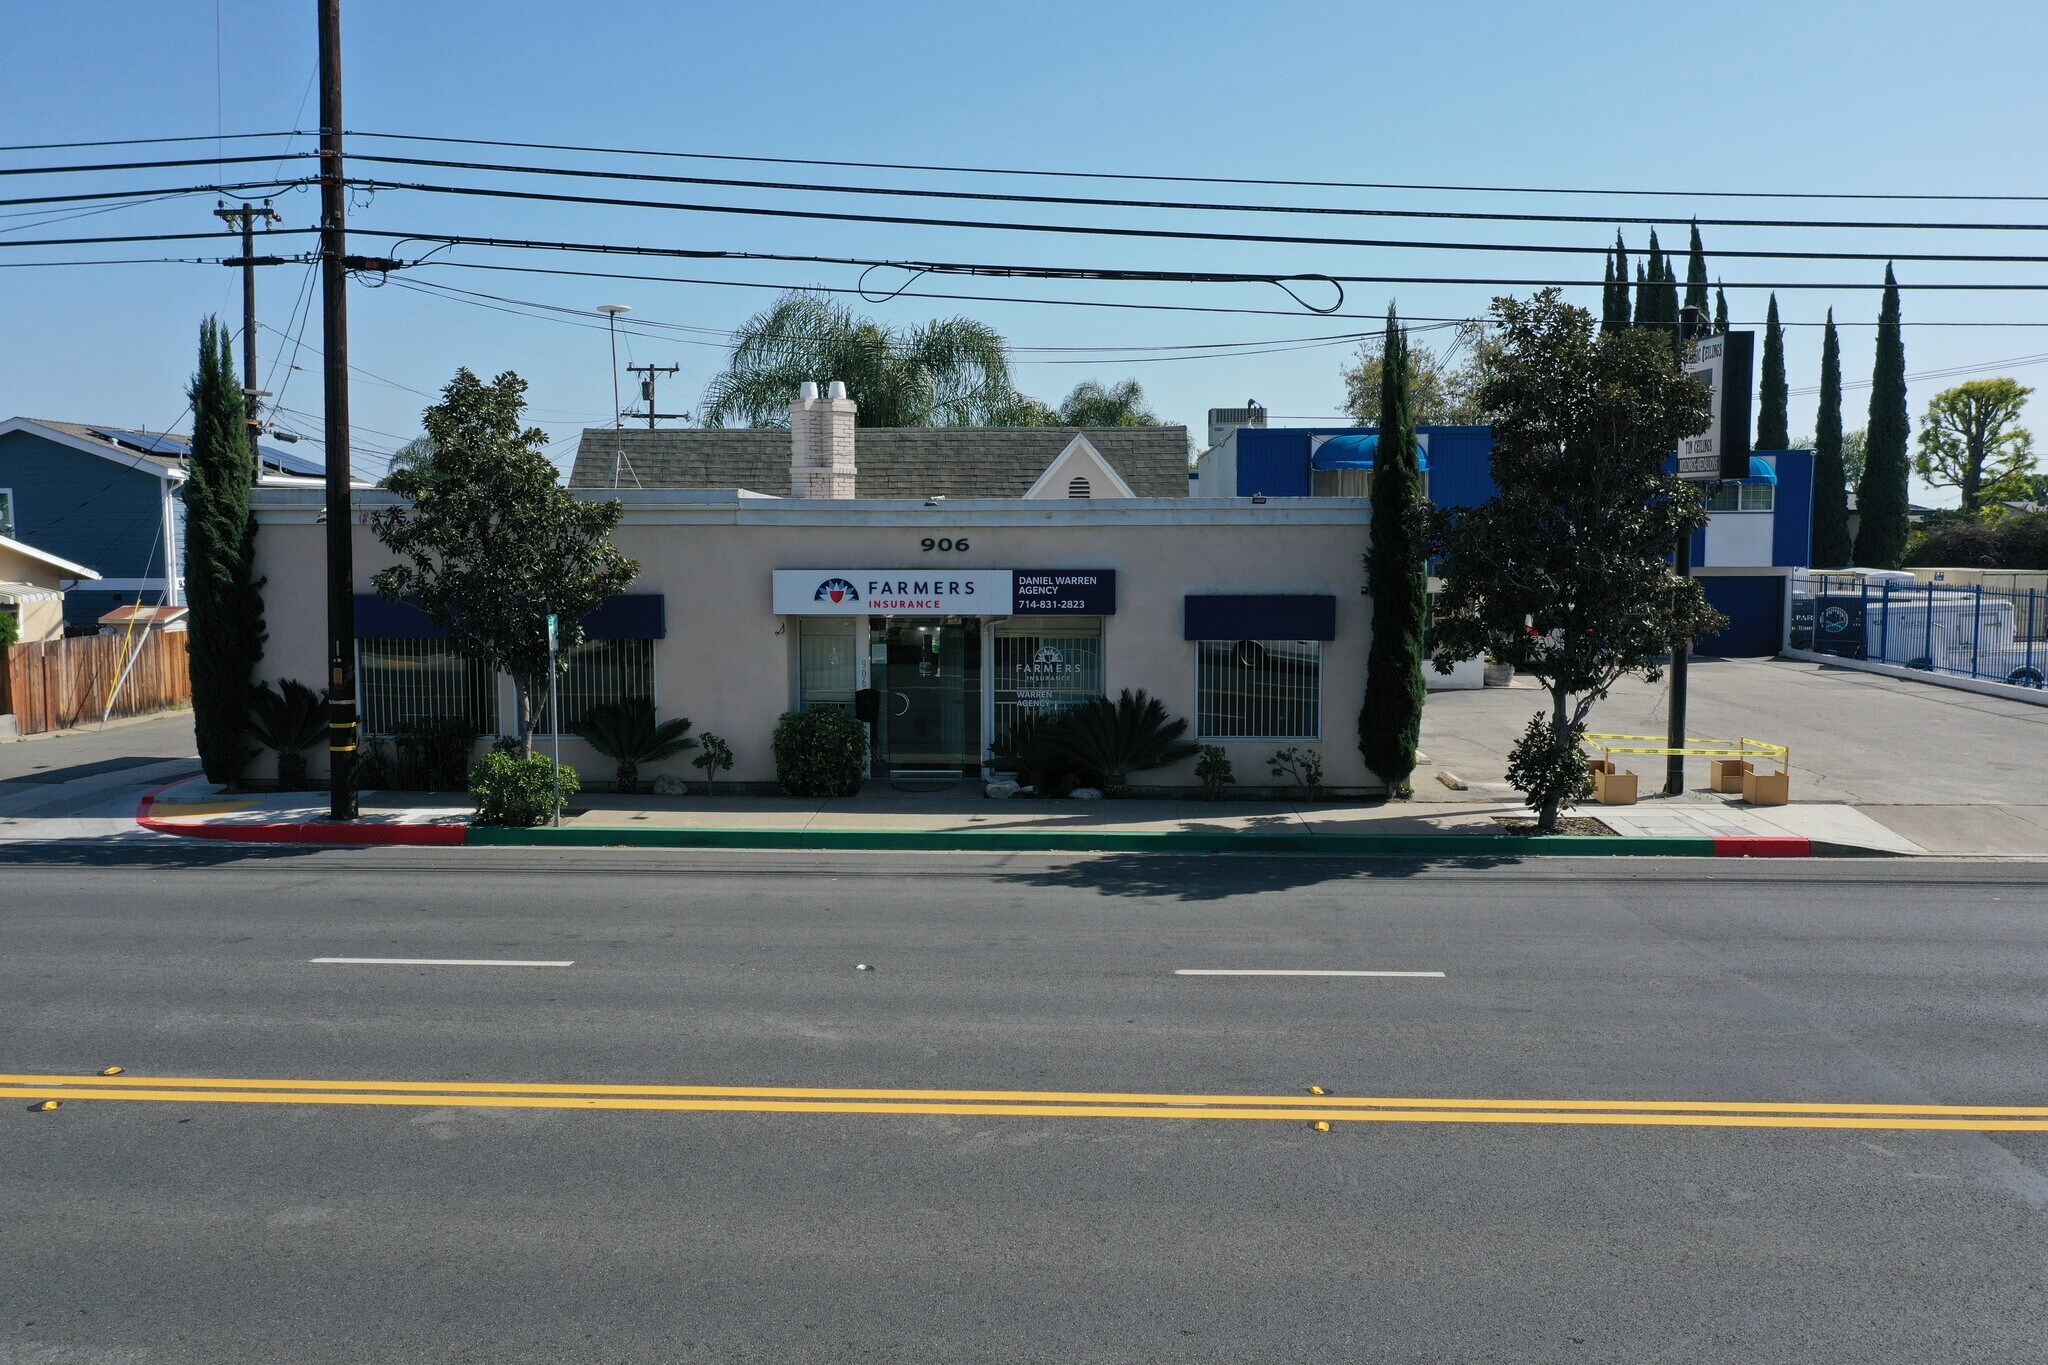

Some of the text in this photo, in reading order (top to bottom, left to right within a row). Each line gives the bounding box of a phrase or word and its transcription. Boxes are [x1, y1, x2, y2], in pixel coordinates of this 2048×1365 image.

[1694, 439, 1712, 453] CEILINGS
[920, 538, 970, 552] 906
[1019, 576, 1097, 585] DANIEL WARREN
[868, 581, 975, 595] FARMERS
[1018, 586, 1059, 595] AGENCY
[868, 600, 940, 609] INSURANCE
[1018, 600, 1085, 609] 714-831-2823
[1016, 664, 1081, 673] FARMERS
